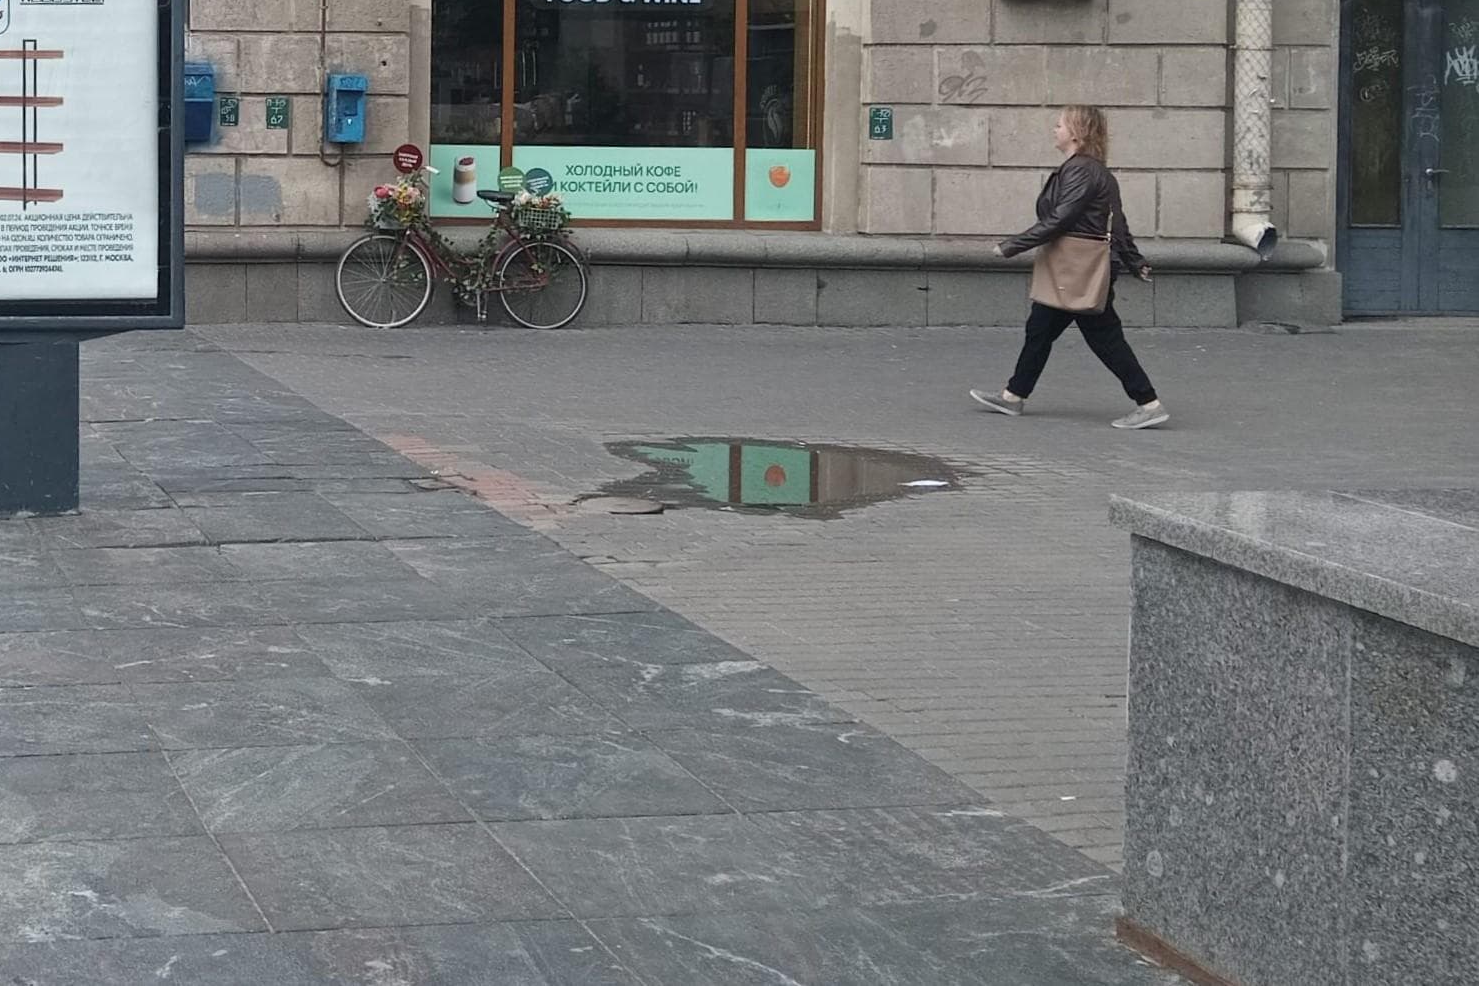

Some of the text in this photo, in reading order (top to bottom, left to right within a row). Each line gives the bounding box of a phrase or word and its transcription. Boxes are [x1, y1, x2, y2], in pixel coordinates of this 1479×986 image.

[565, 162, 682, 178] ХОЛОДНЫЙ КОФЕ
[560, 178, 630, 194] КОКТЕЙЛИ
[634, 182, 643, 194] С
[646, 179, 698, 194] СОБОЙ!
